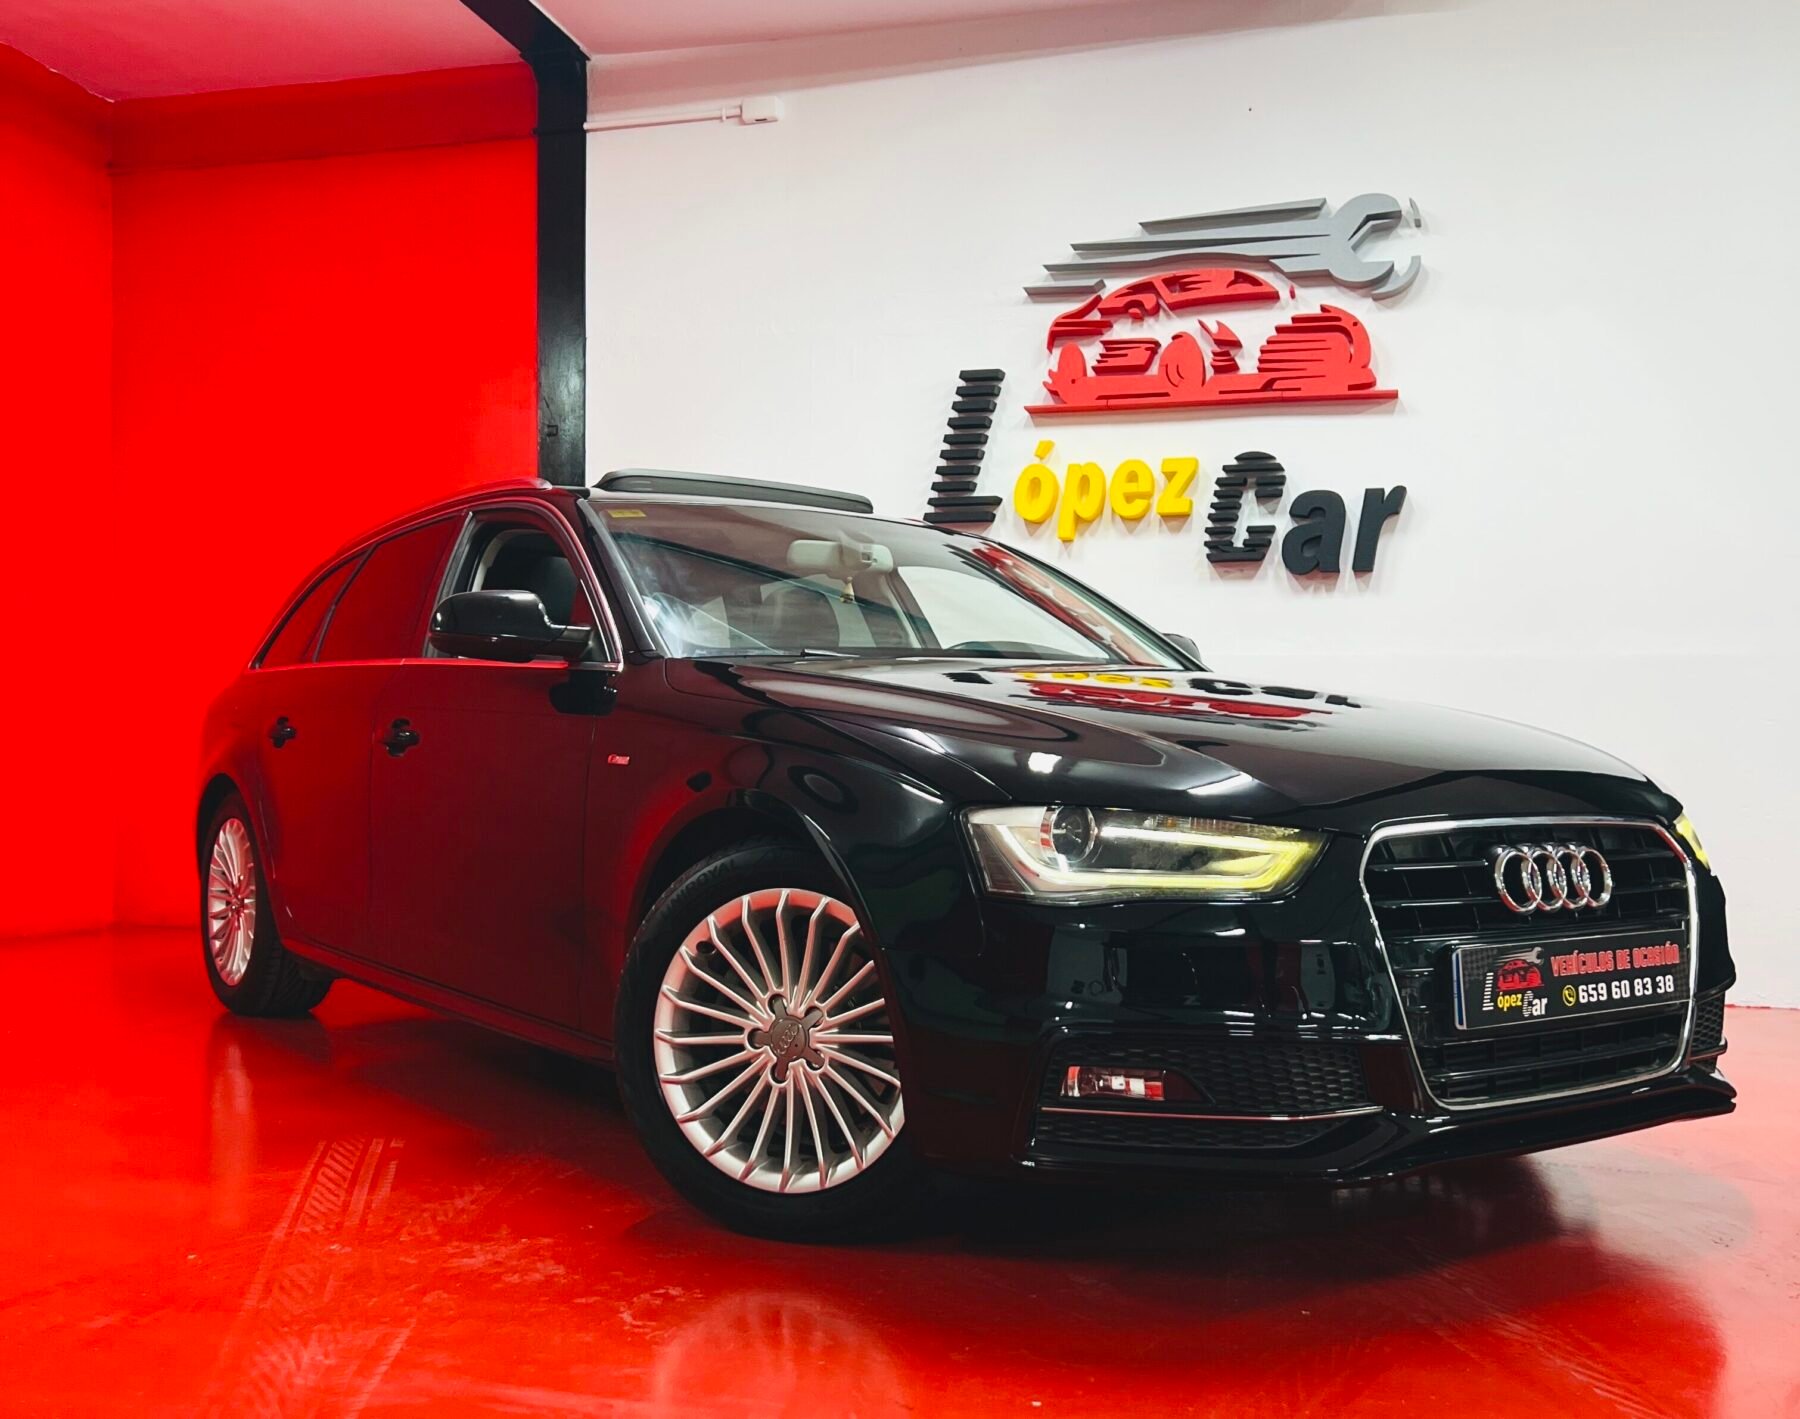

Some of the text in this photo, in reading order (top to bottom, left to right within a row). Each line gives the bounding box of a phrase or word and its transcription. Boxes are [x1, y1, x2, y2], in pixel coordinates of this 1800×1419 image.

[923, 368, 1407, 573] López Car
[1550, 940, 1680, 977] VEHÍCULOS DE OCASIÓN
[1482, 972, 1548, 1017] López Car
[1578, 974, 1674, 1003] 659 60 83 38
